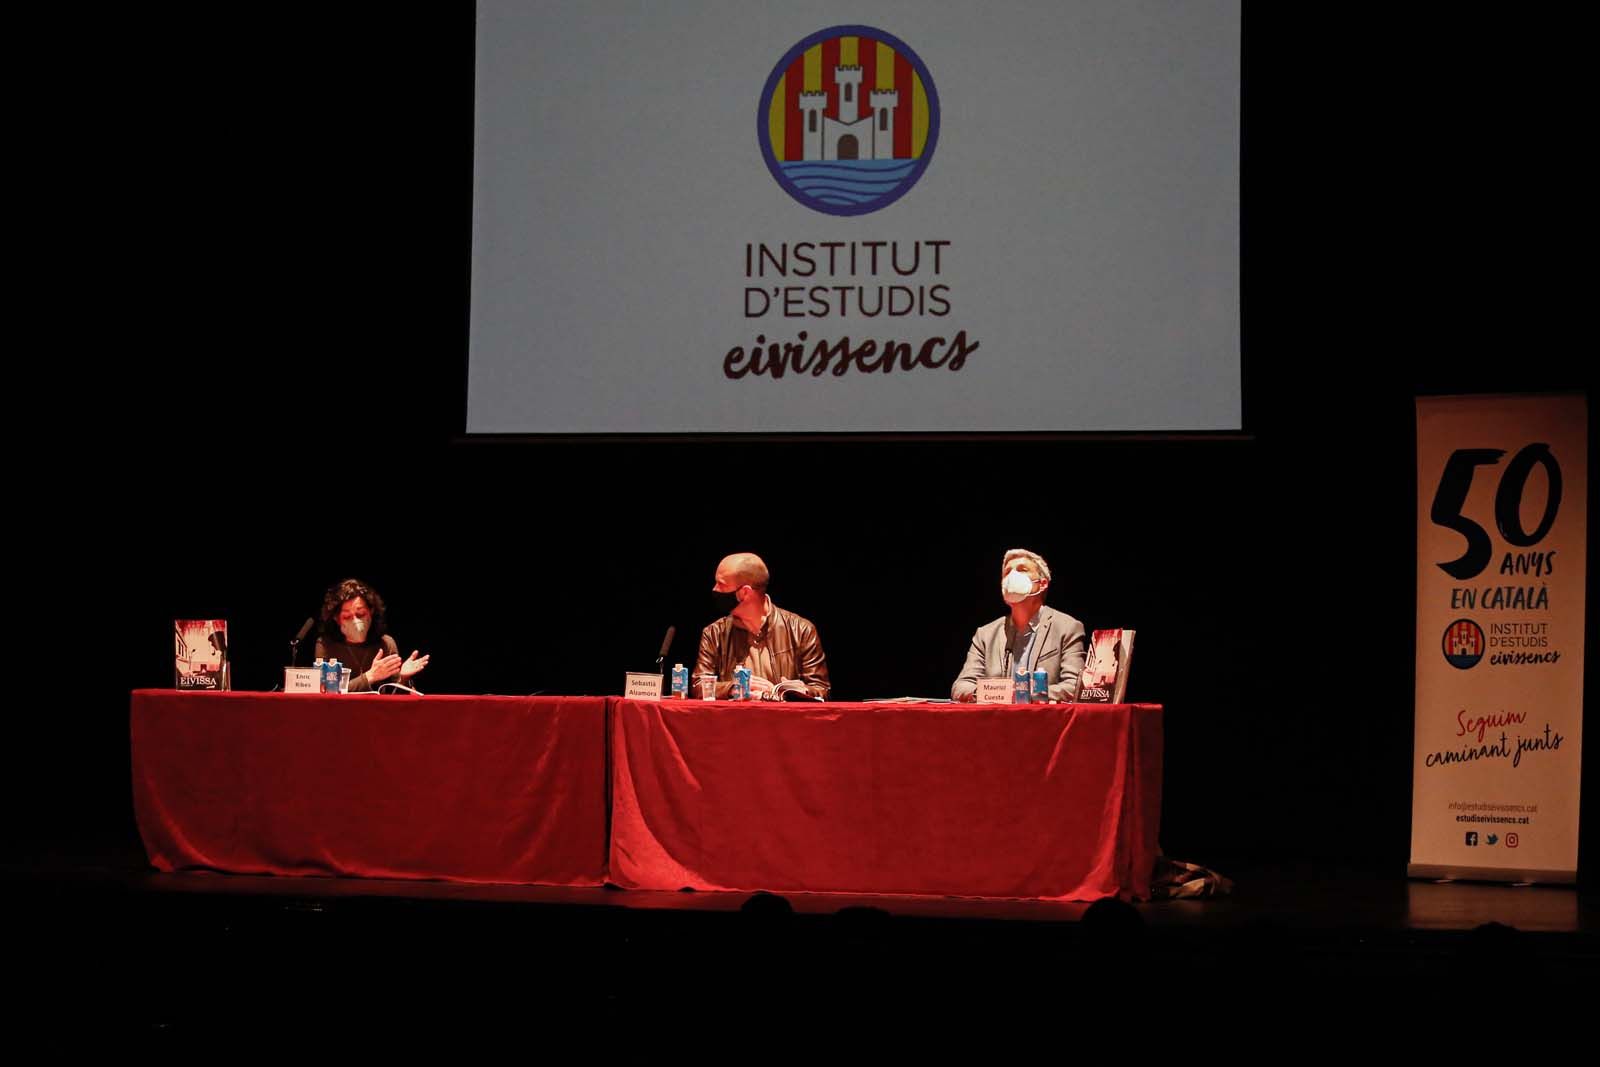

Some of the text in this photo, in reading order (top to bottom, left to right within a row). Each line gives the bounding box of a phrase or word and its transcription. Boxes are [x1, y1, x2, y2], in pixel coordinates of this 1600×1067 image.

[745, 241, 951, 277] INSTITUT
[744, 284, 951, 318] D'ESTUDIS
[722, 330, 980, 380] eivissencs
[1430, 442, 1563, 581] 50
[1500, 551, 1556, 577] ANYS
[1451, 582, 1549, 611] EN CATALÀ
[1489, 636, 1548, 648] D'ESTUDIS
[1490, 623, 1549, 635] INSTITUT
[1490, 650, 1561, 666] eivissencs
[180, 676, 217, 686] EIVISSA
[1081, 688, 1110, 698] EIVISSA
[1456, 709, 1527, 743] Seguim
[1425, 723, 1564, 768] caminant junts
[1456, 814, 1530, 825] estudiseivissencs.cat
